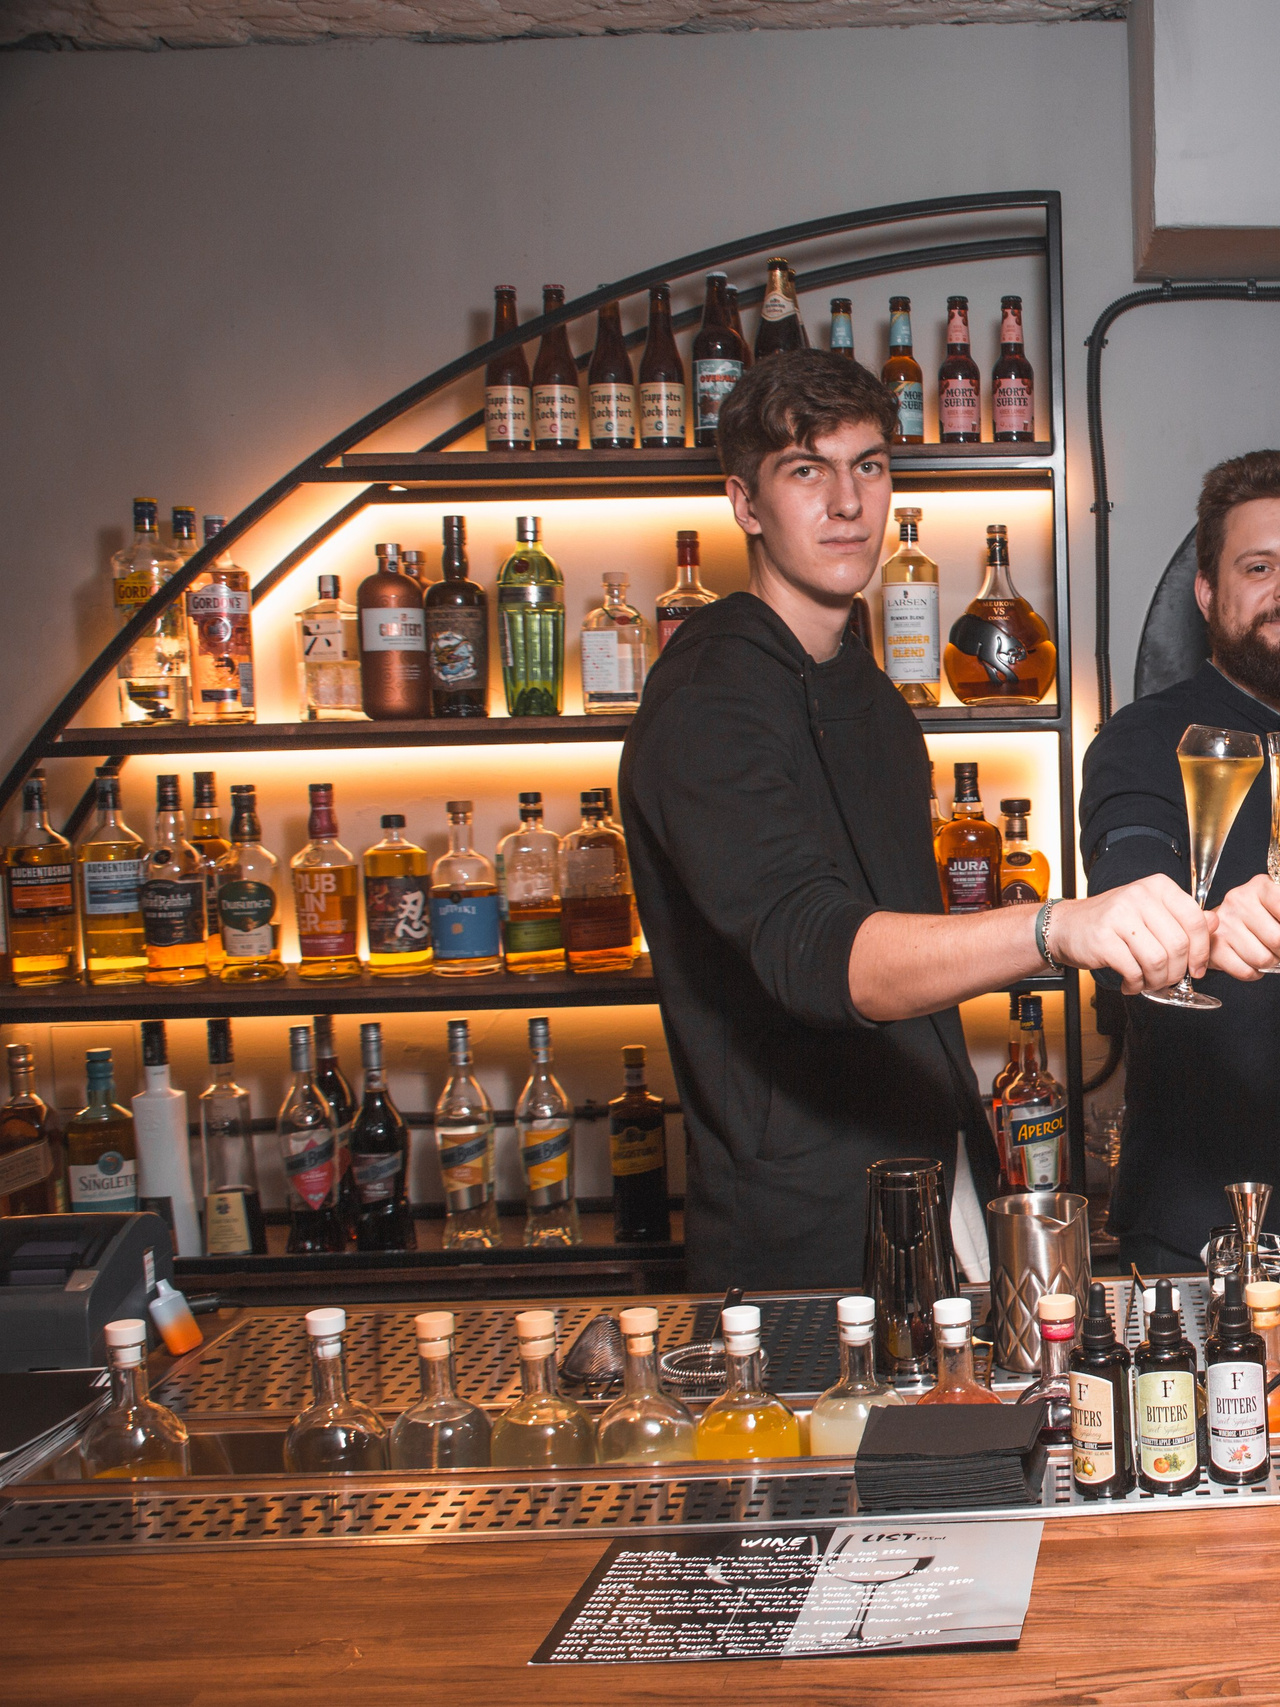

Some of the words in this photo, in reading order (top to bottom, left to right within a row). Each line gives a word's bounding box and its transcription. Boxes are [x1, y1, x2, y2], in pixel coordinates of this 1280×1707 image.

[535, 391, 576, 405] Trappstes
[590, 390, 631, 404] Trappstes
[641, 389, 681, 403] Trappstes
[946, 388, 975, 398] MORT
[998, 387, 1026, 398] MORT
[901, 401, 923, 411] SUBI
[944, 398, 976, 408] SUBITE
[996, 397, 1028, 407] SUBITE
[192, 596, 242, 609] GORDON'S
[887, 598, 928, 606] LARSEN
[993, 607, 1005, 615] VS
[888, 635, 930, 644] SUMMER
[892, 648, 925, 658] BLEND
[949, 861, 989, 871] JURA
[1017, 1116, 1064, 1142] APEROL
[1230, 1372, 1244, 1390] F
[1077, 1383, 1088, 1401] F
[1161, 1379, 1175, 1398] F
[1216, 1395, 1257, 1415] BITTERS
[1146, 1403, 1188, 1423] BITTERS
[740, 1536, 809, 1548] WINE
[861, 1532, 917, 1542] LIST
[597, 1582, 635, 1590] White
[607, 1616, 619, 1624] &
[622, 1616, 652, 1624] Red
